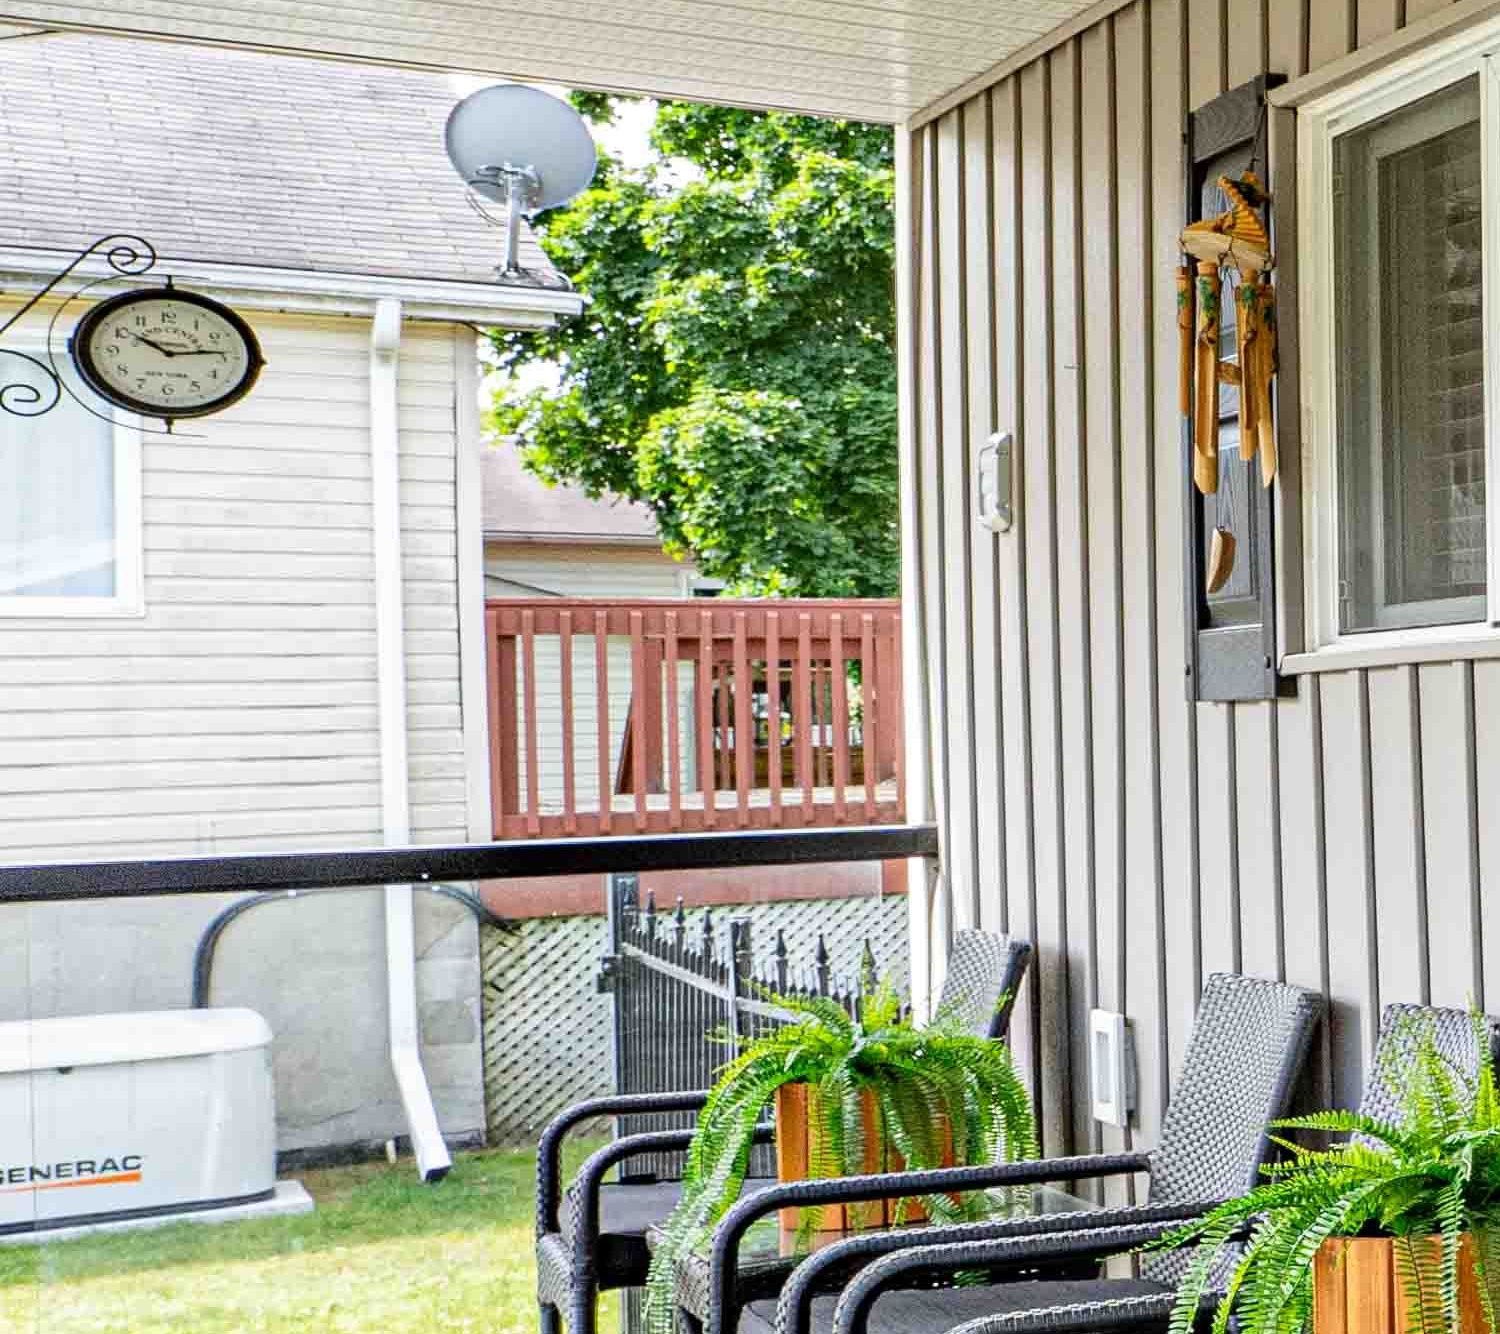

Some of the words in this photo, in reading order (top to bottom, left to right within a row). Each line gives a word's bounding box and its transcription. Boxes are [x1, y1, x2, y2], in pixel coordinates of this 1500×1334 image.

[136, 316, 146, 327] 11
[161, 311, 176, 324] 12
[115, 327, 129, 339] 10
[209, 332, 220, 344] 2
[106, 345, 120, 357] 9
[117, 364, 128, 376] 8
[208, 369, 217, 379] 4
[136, 378, 146, 389] 7
[162, 384, 174, 395] 6
[190, 381, 200, 392] 5
[0, 1155, 142, 1185] ENERAC
